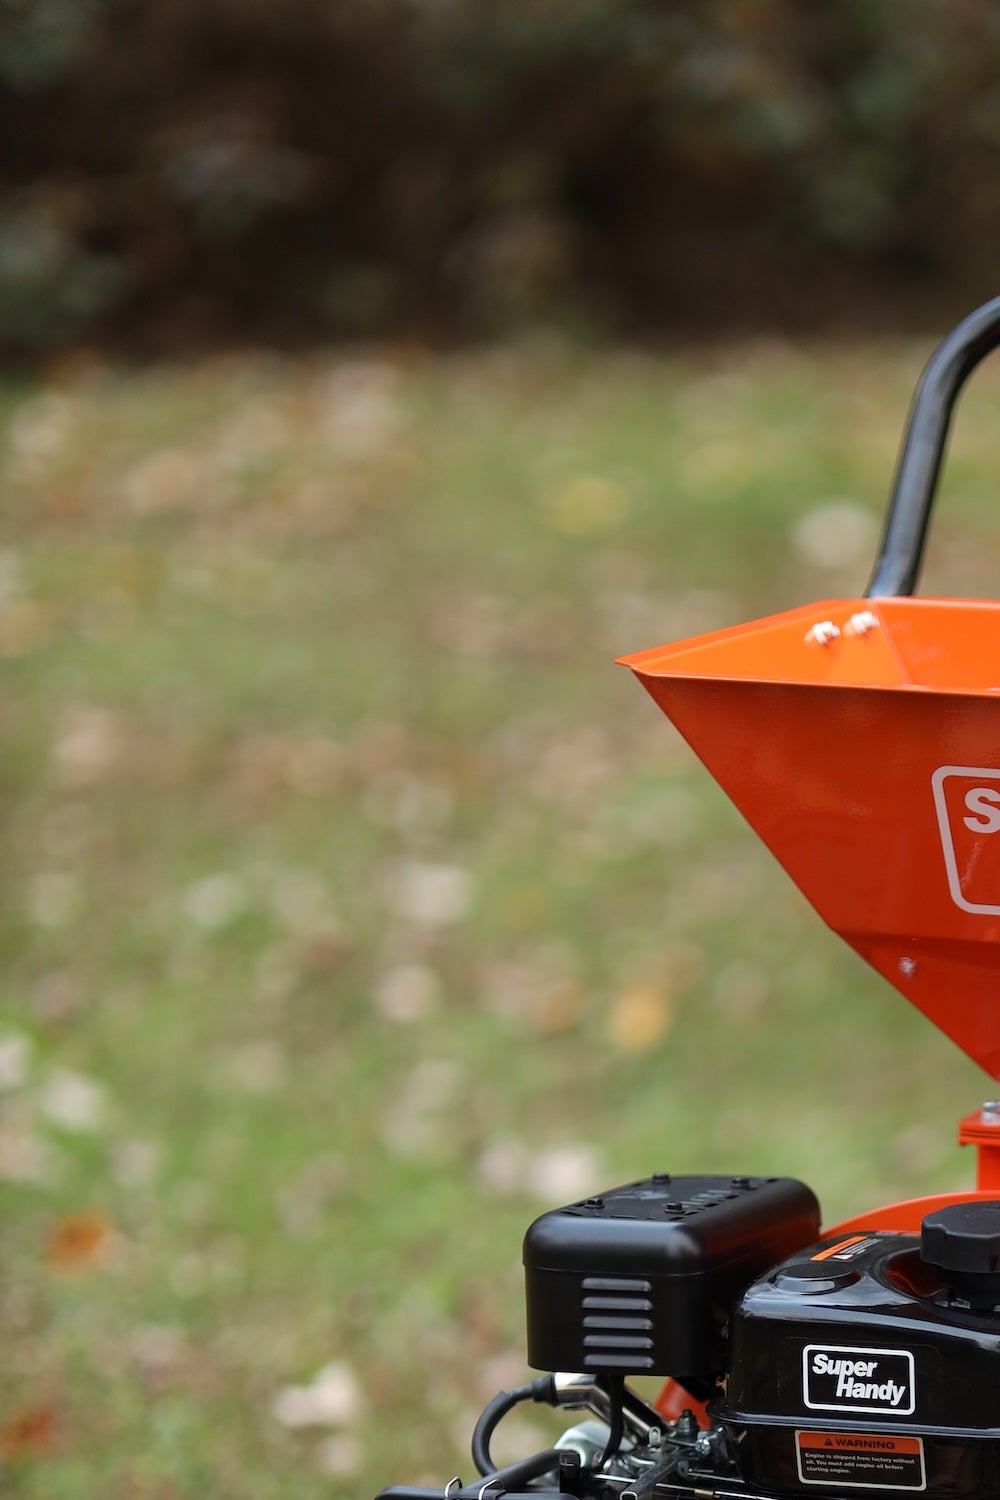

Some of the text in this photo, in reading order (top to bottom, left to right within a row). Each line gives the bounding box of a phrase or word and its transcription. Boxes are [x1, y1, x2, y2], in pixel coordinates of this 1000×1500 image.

[812, 1354, 878, 1380] Super
[836, 1377, 906, 1406] Handy
[835, 1439, 895, 1449] WARNING
